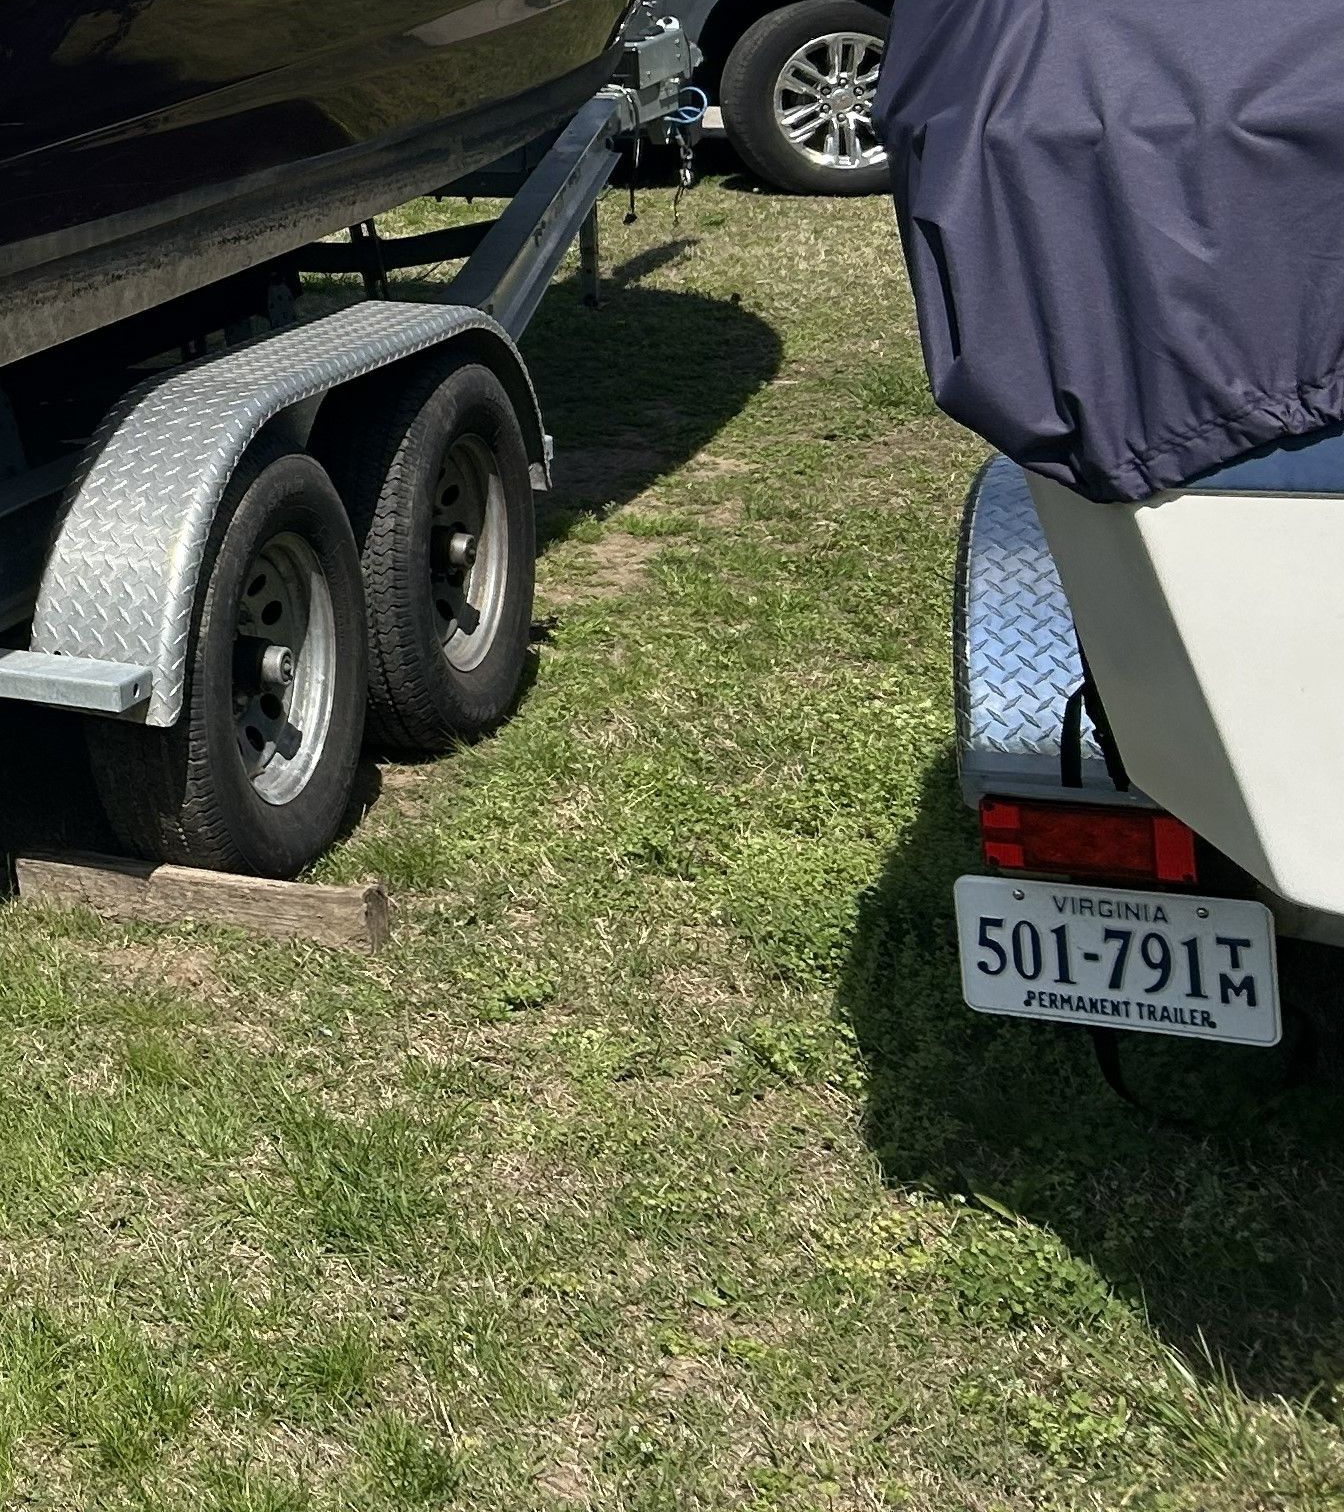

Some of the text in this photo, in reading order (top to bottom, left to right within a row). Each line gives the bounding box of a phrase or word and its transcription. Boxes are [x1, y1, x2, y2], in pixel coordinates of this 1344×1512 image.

[1053, 896, 1168, 924] VIRGINIA
[977, 916, 1208, 999] 501-791
[1025, 990, 1214, 1028] PERMANENT TRAILER
